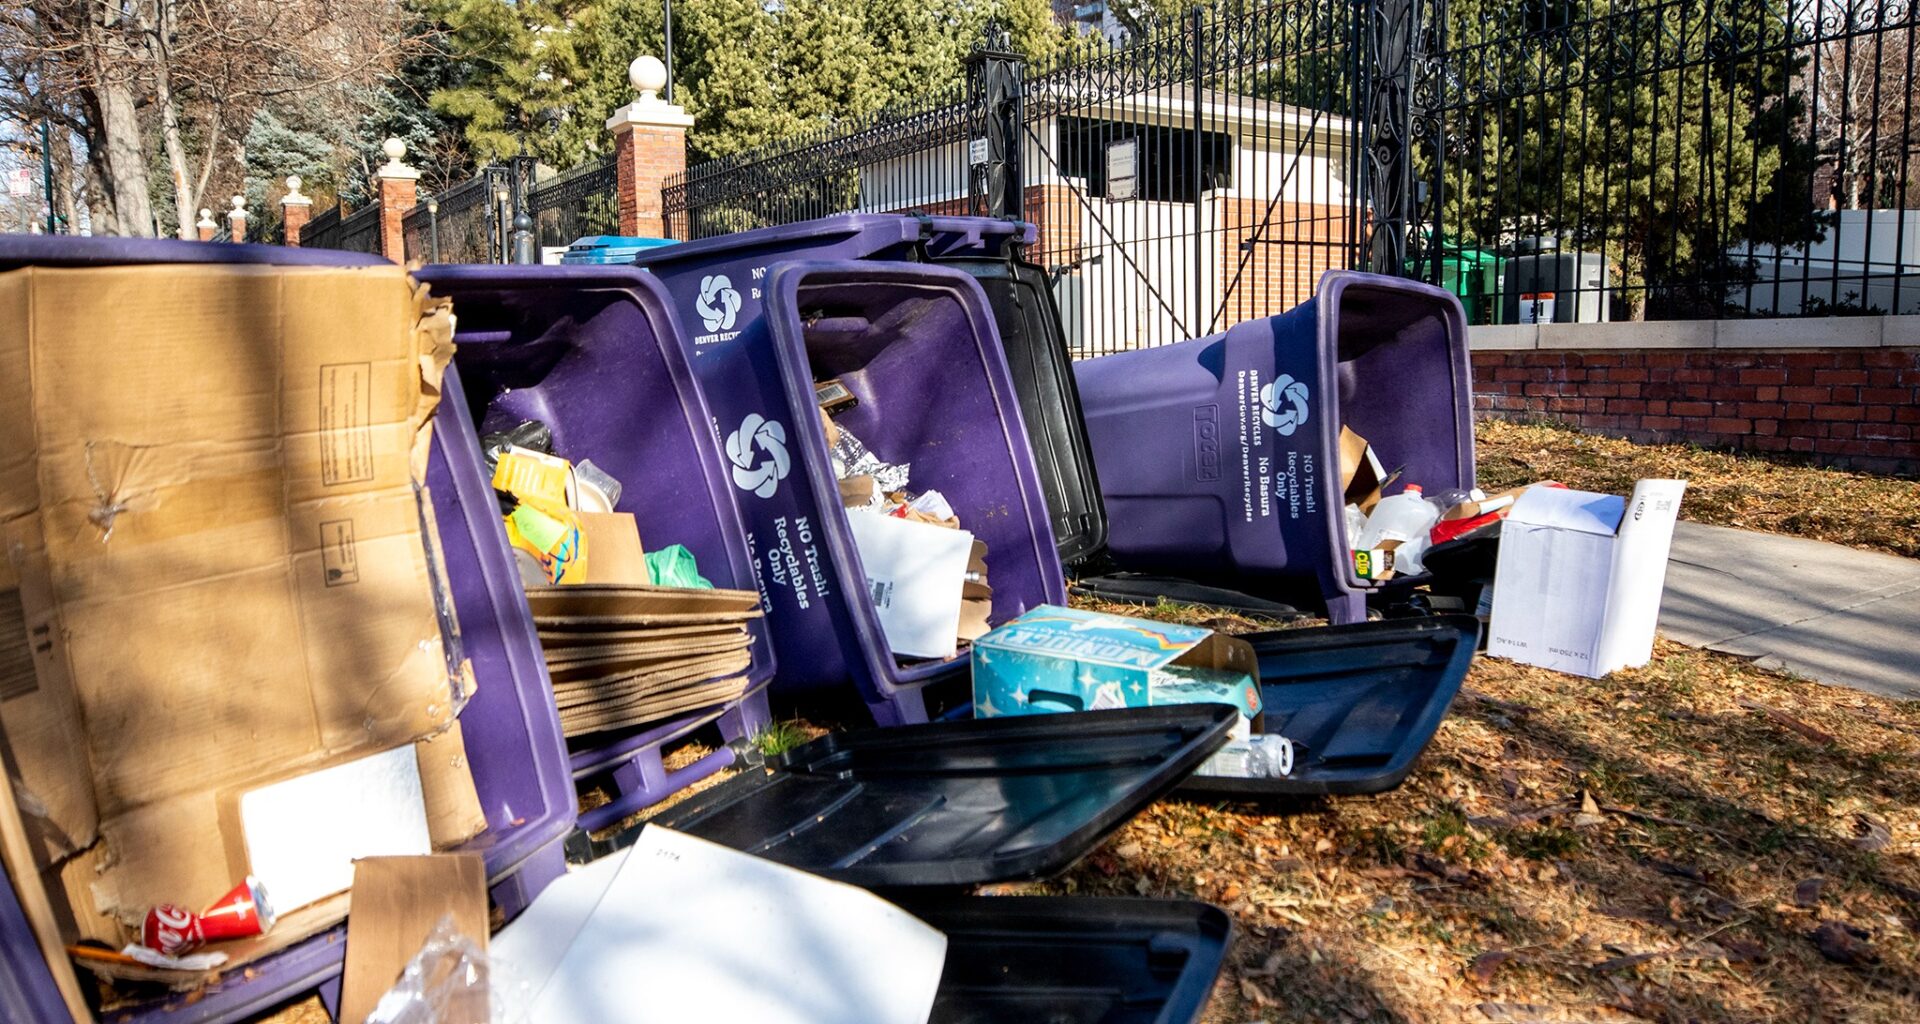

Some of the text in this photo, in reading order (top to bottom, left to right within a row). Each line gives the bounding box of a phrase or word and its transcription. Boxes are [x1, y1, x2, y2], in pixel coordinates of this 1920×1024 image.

[695, 334, 719, 345] DENVER
[1250, 369, 1262, 446] DENVER RECYCLES
[1238, 370, 1253, 522] DenverGov.org/DenverRecycles
[1258, 457, 1270, 517] No Basura
[1275, 471, 1288, 500] Only
[1287, 451, 1300, 519] Recyclables
[1303, 455, 1316, 513] NO Trash!
[768, 548, 786, 587] Only
[774, 516, 810, 610] Recyclables
[795, 516, 830, 597] NO Trash!
[1357, 552, 1369, 575] CLUB
[1559, 649, 1573, 657] 750
[1580, 652, 1589, 660] 12
